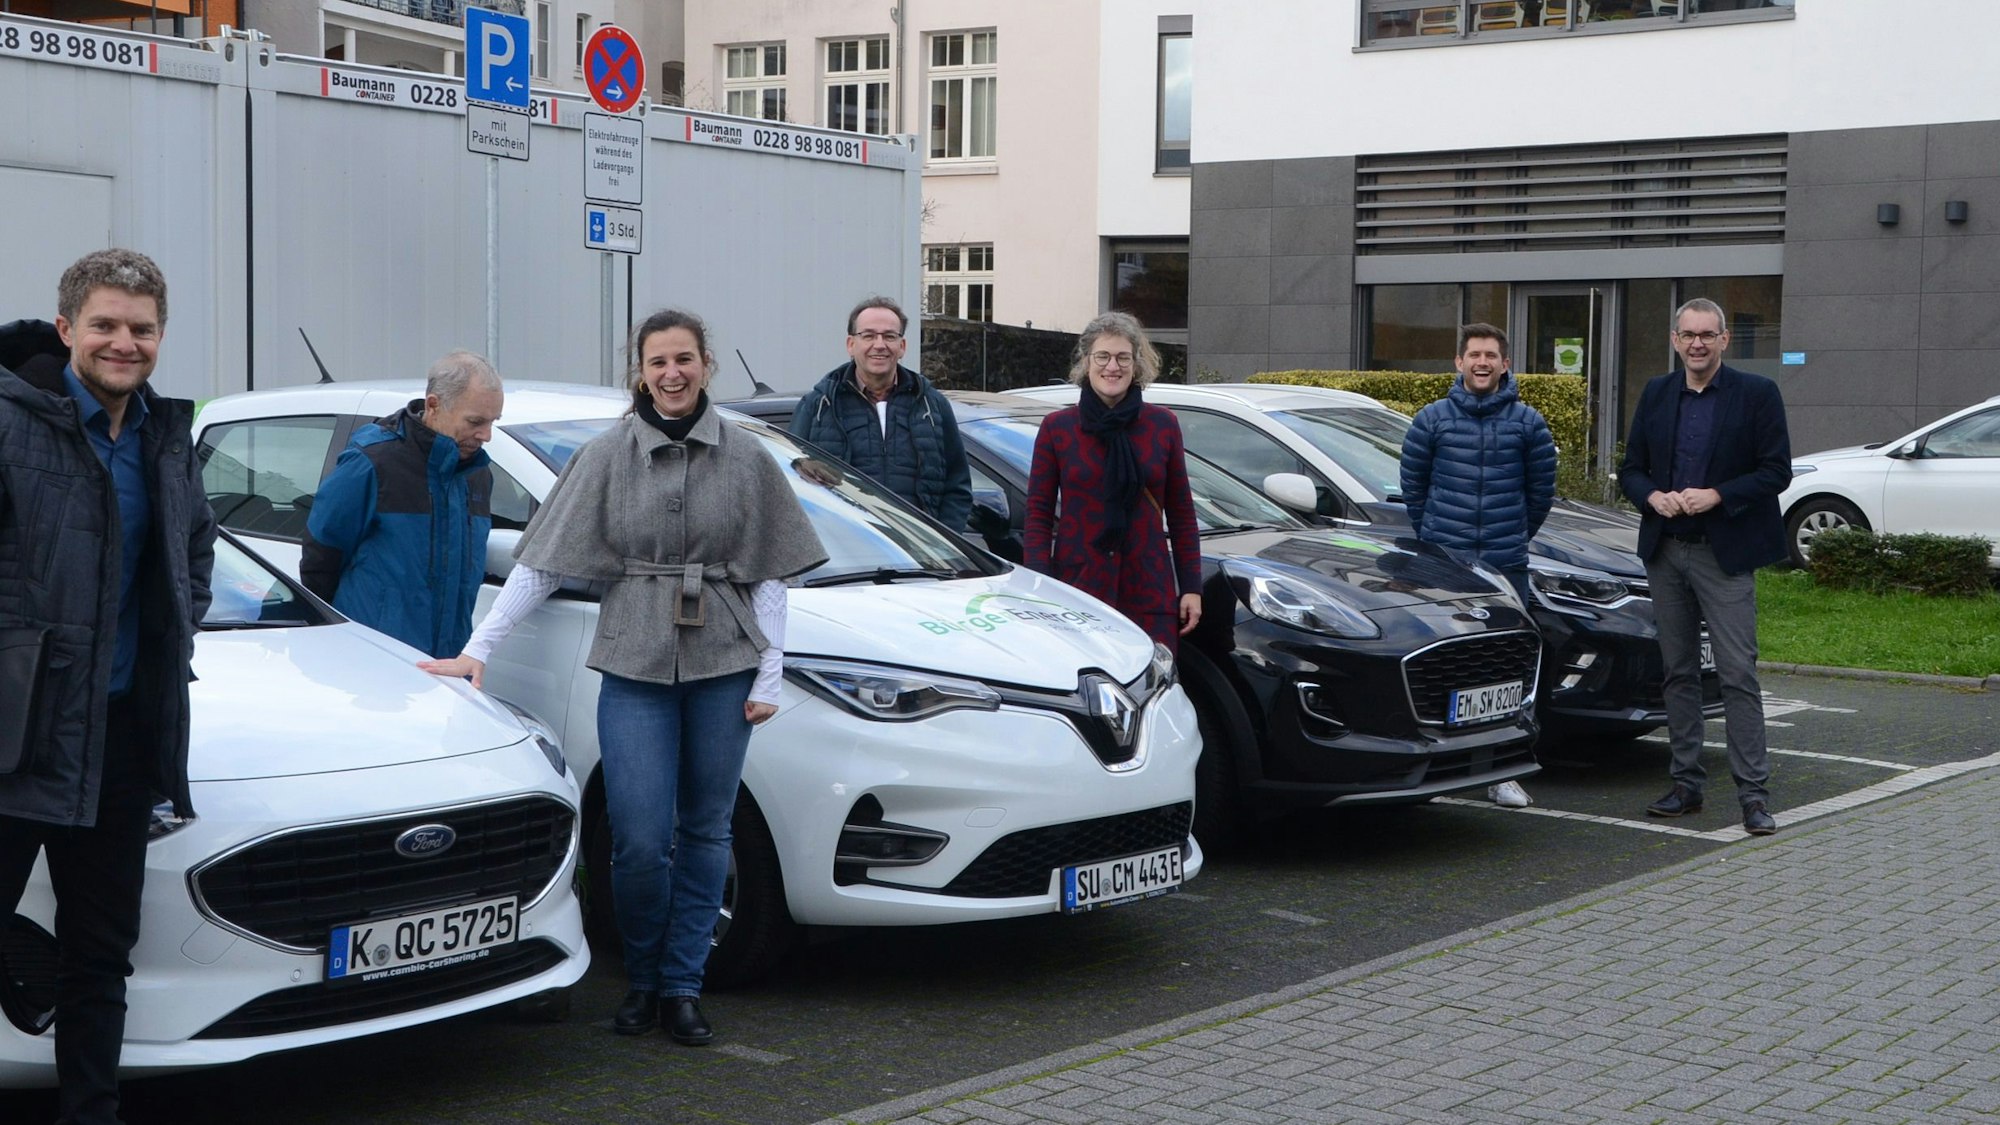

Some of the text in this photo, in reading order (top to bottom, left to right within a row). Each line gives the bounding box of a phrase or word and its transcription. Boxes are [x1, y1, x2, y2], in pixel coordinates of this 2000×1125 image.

[0, 27, 144, 66] 8 98 98 081
[481, 22, 515, 90] P
[331, 72, 395, 93] Baumann
[410, 84, 457, 108] 0228
[355, 90, 395, 102] CONTAINER
[491, 119, 507, 132] mit
[472, 131, 525, 150] Parkschein
[589, 128, 639, 146] Elektrofahrzeuge
[694, 119, 742, 138] Baumann
[753, 129, 789, 150] 0228
[794, 135, 812, 153] 98
[815, 137, 833, 156] 98
[836, 142, 859, 159] 081
[711, 134, 742, 146] CONTAINER
[595, 145, 632, 159] während des
[593, 159, 634, 175] Ladevorgangs
[608, 176, 620, 187] frei
[609, 222, 637, 239] 3 Std.
[1457, 684, 1521, 718] EM SW 8200
[411, 831, 444, 851] Ford
[1077, 867, 1100, 901] SU
[1112, 861, 1135, 894] CM
[334, 901, 515, 969] D K QC 5725
[362, 949, 490, 982] www.cambio-CarSharing.de
